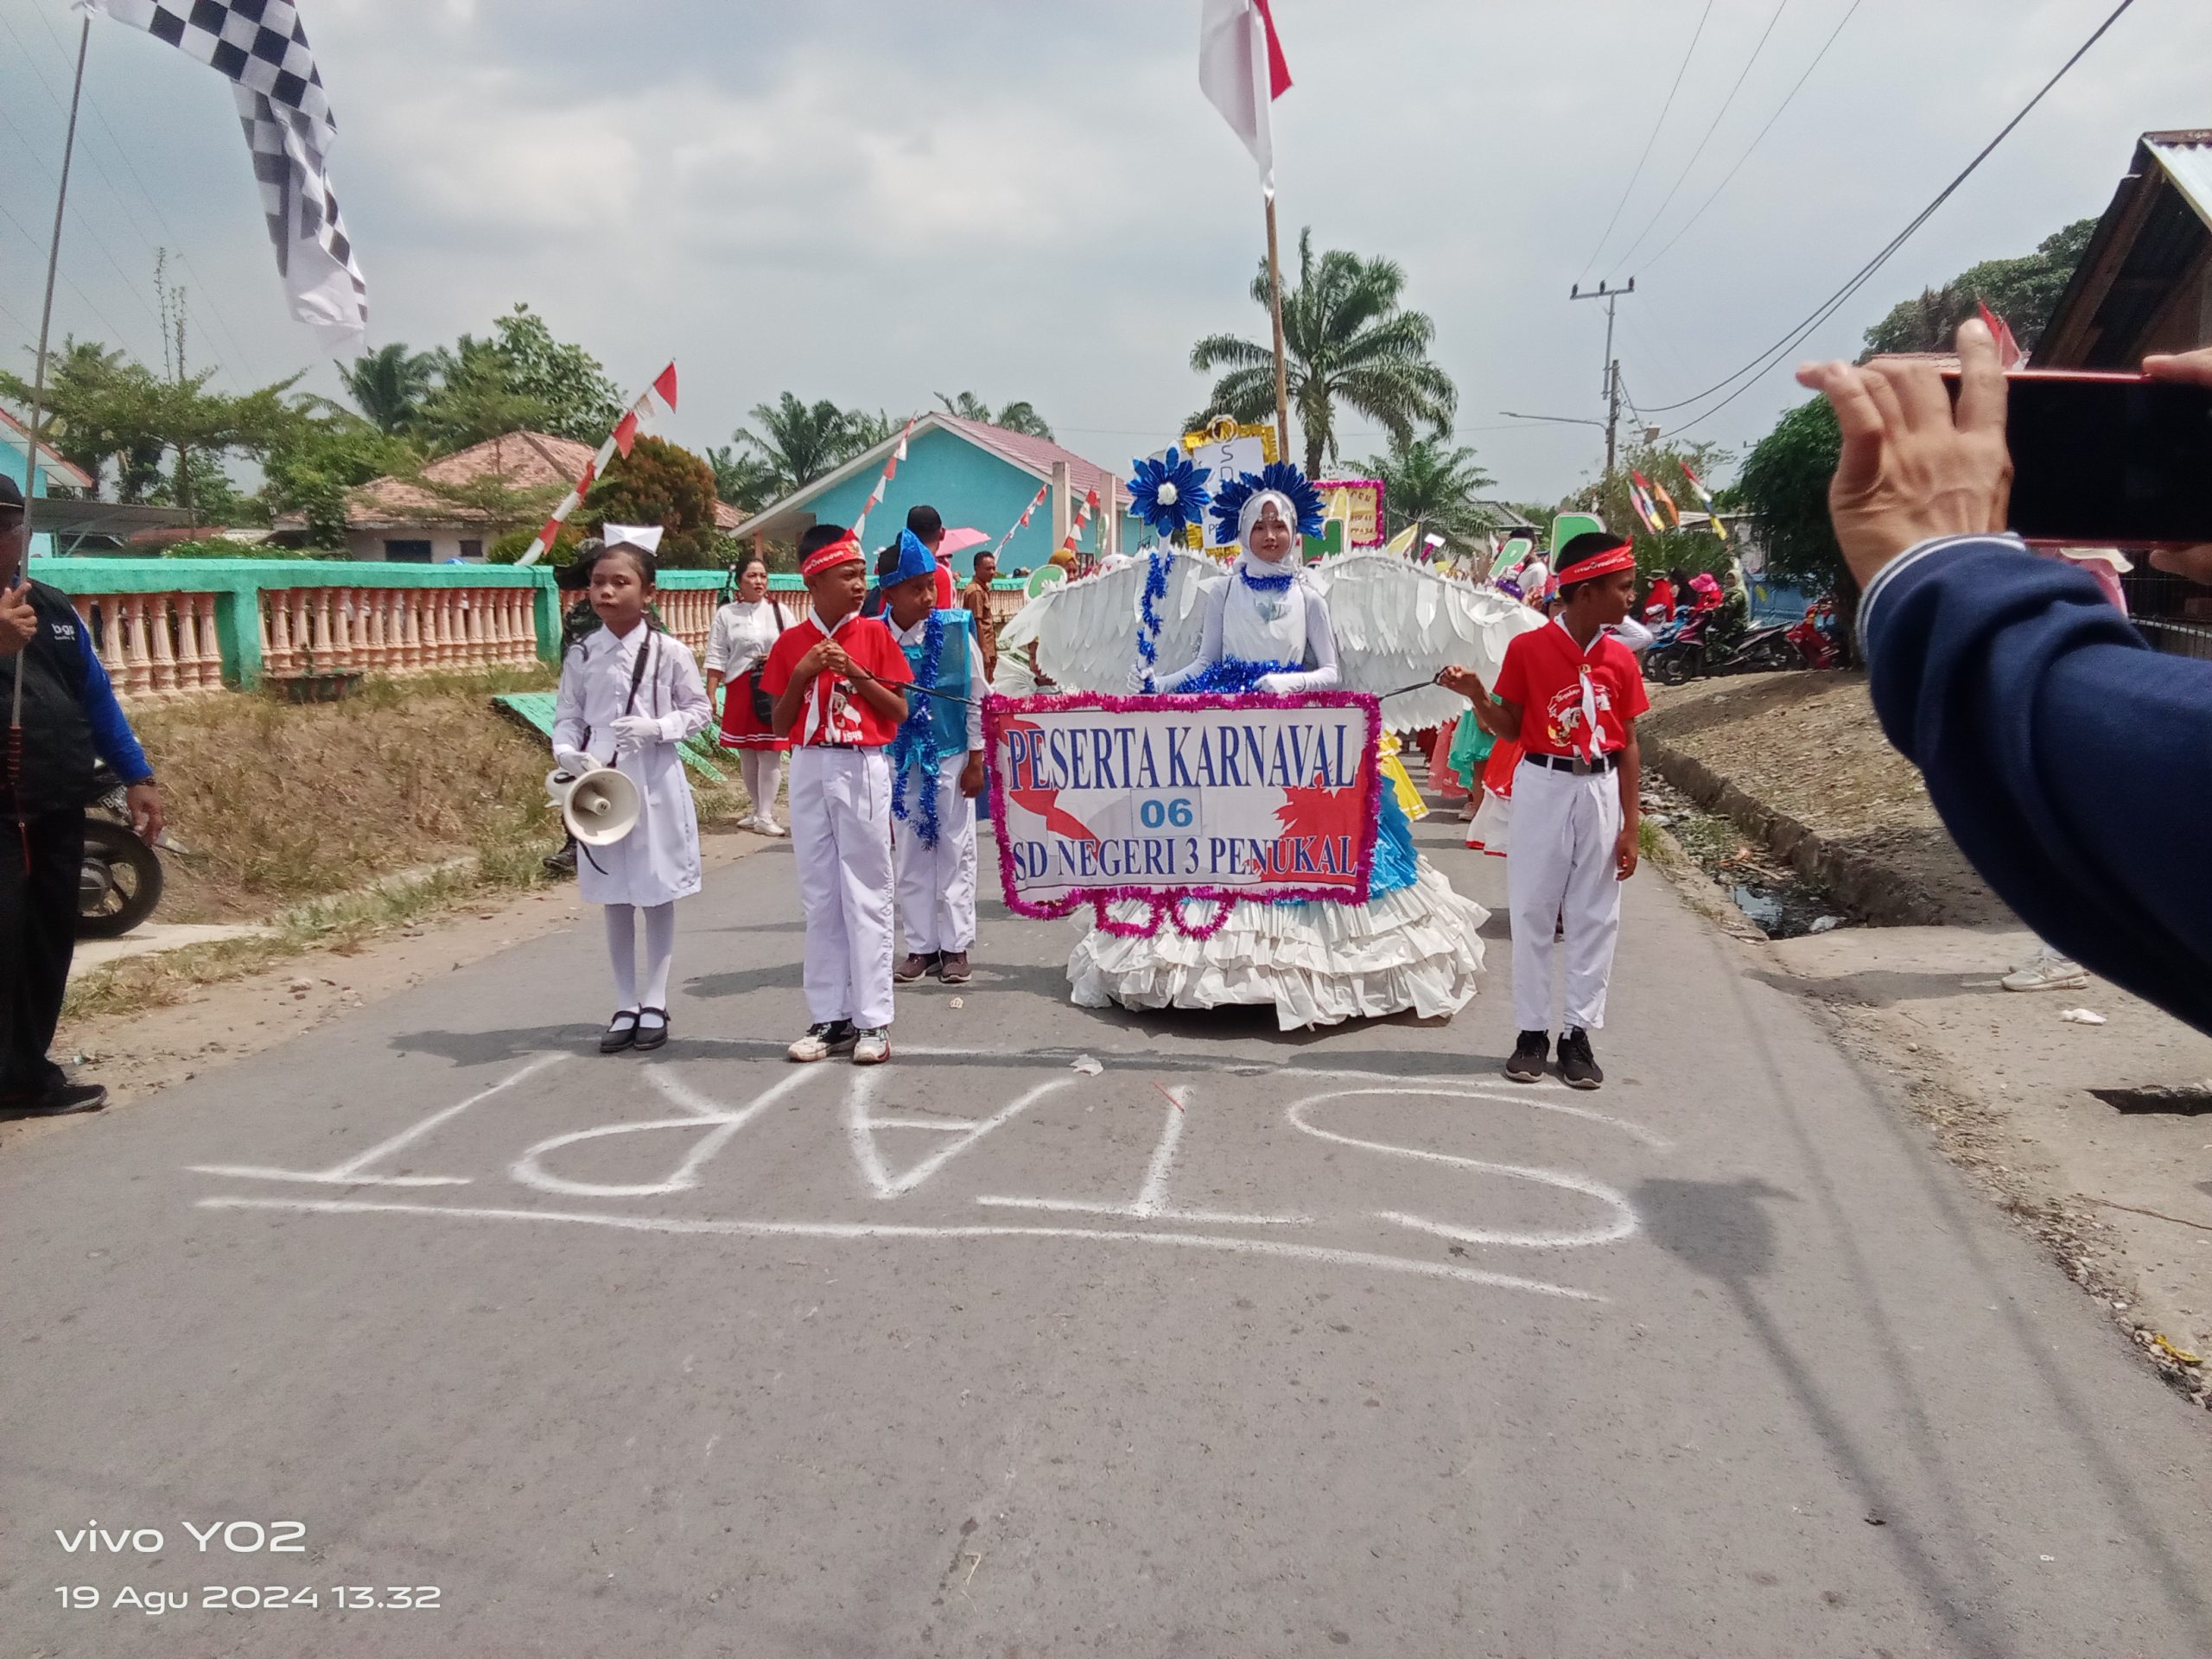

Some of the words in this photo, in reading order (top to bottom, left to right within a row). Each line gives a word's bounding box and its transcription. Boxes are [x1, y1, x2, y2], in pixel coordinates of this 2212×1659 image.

[1006, 727, 1161, 791] PESERTA
[1166, 724, 1357, 788] KARNAVAL
[1140, 798, 1194, 829] 06
[1013, 841, 1049, 881] SD
[1057, 838, 1176, 878] NEGERI
[1185, 837, 1199, 874] 3
[1210, 835, 1357, 877] PENUKAL
[183, 1050, 1678, 1251] START
